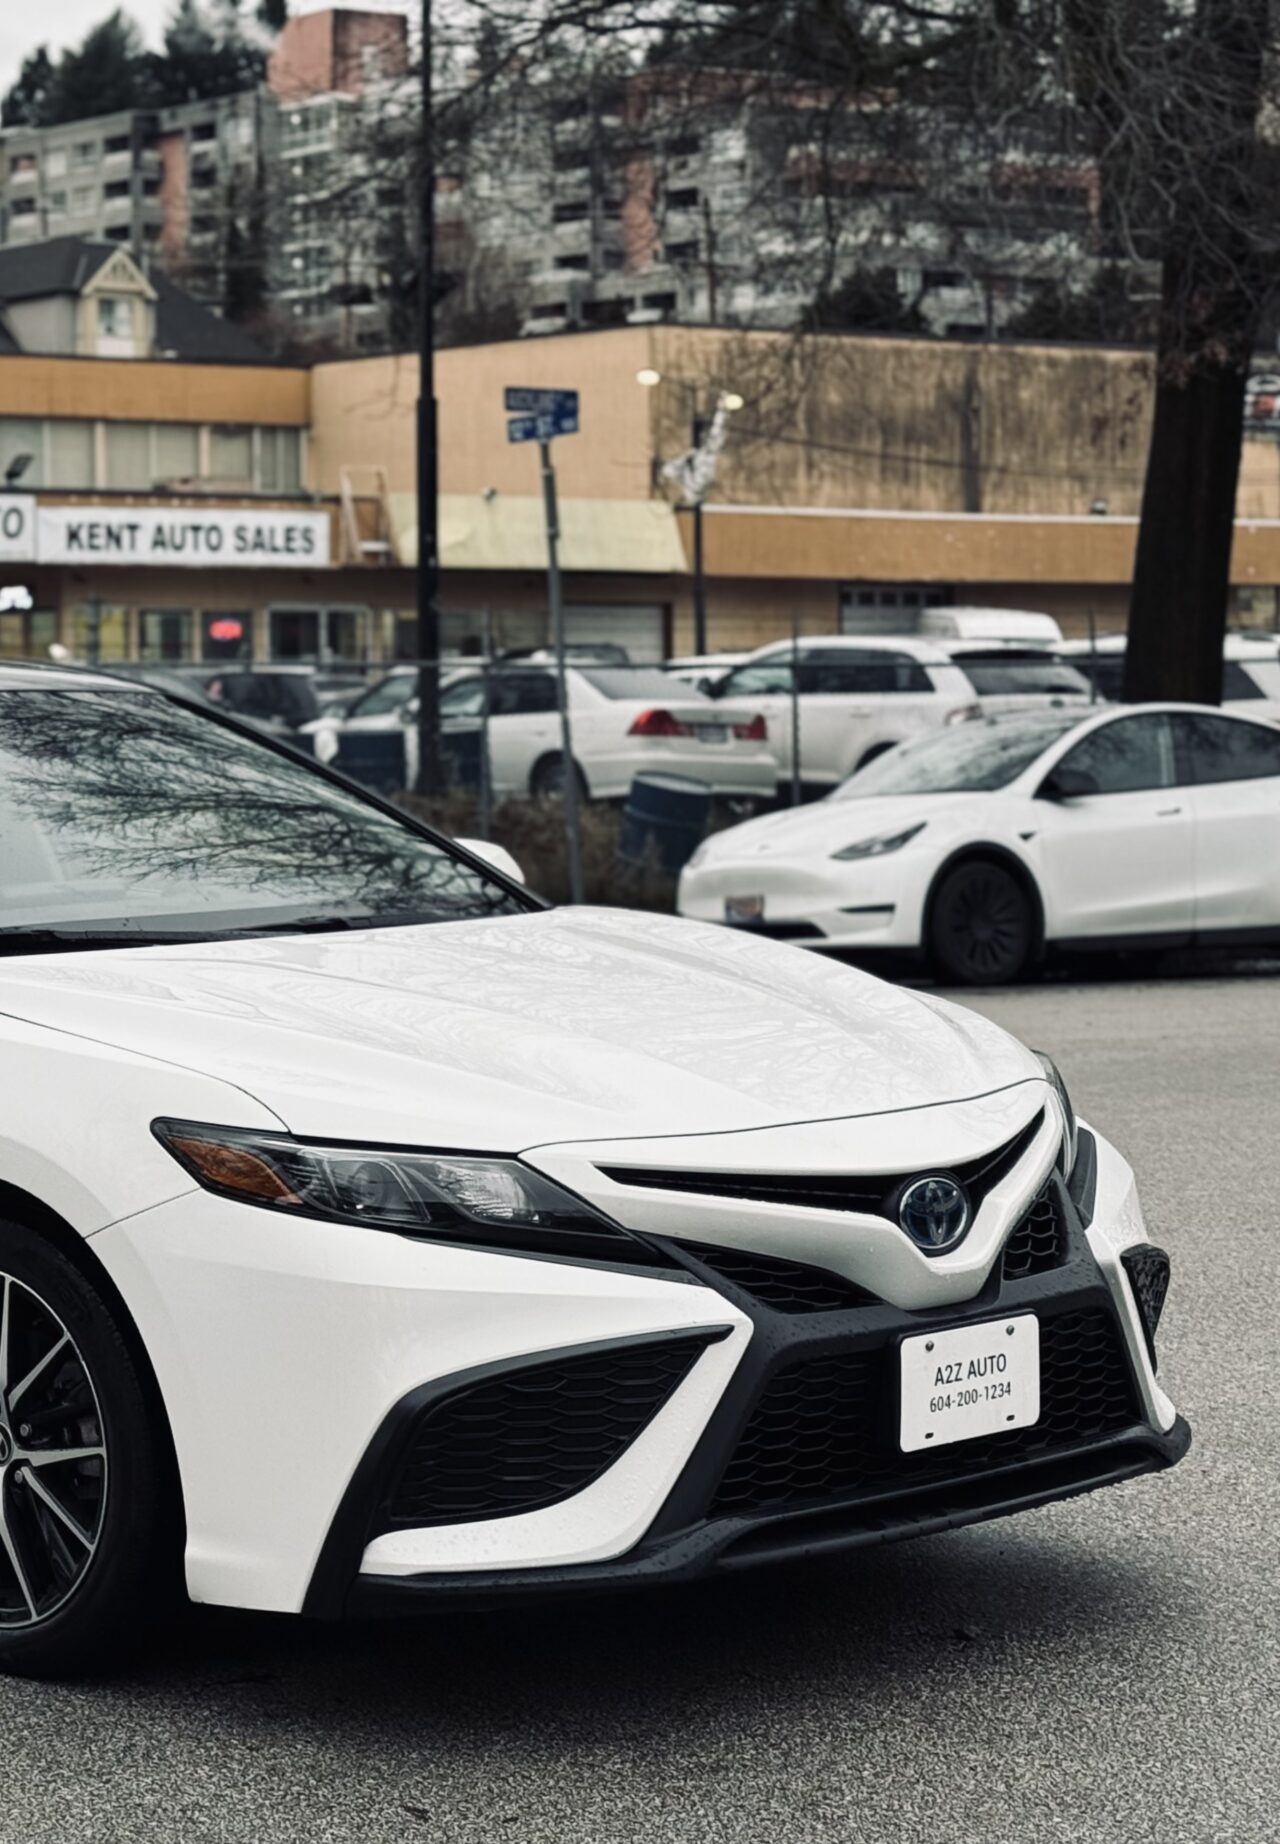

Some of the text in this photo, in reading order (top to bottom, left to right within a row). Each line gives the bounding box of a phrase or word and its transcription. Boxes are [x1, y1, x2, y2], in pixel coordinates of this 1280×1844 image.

[66, 523, 315, 553] KENT AUTO SALES
[934, 1353, 1007, 1386] A2Z AUTO
[930, 1382, 1012, 1413] 604-200-1234
